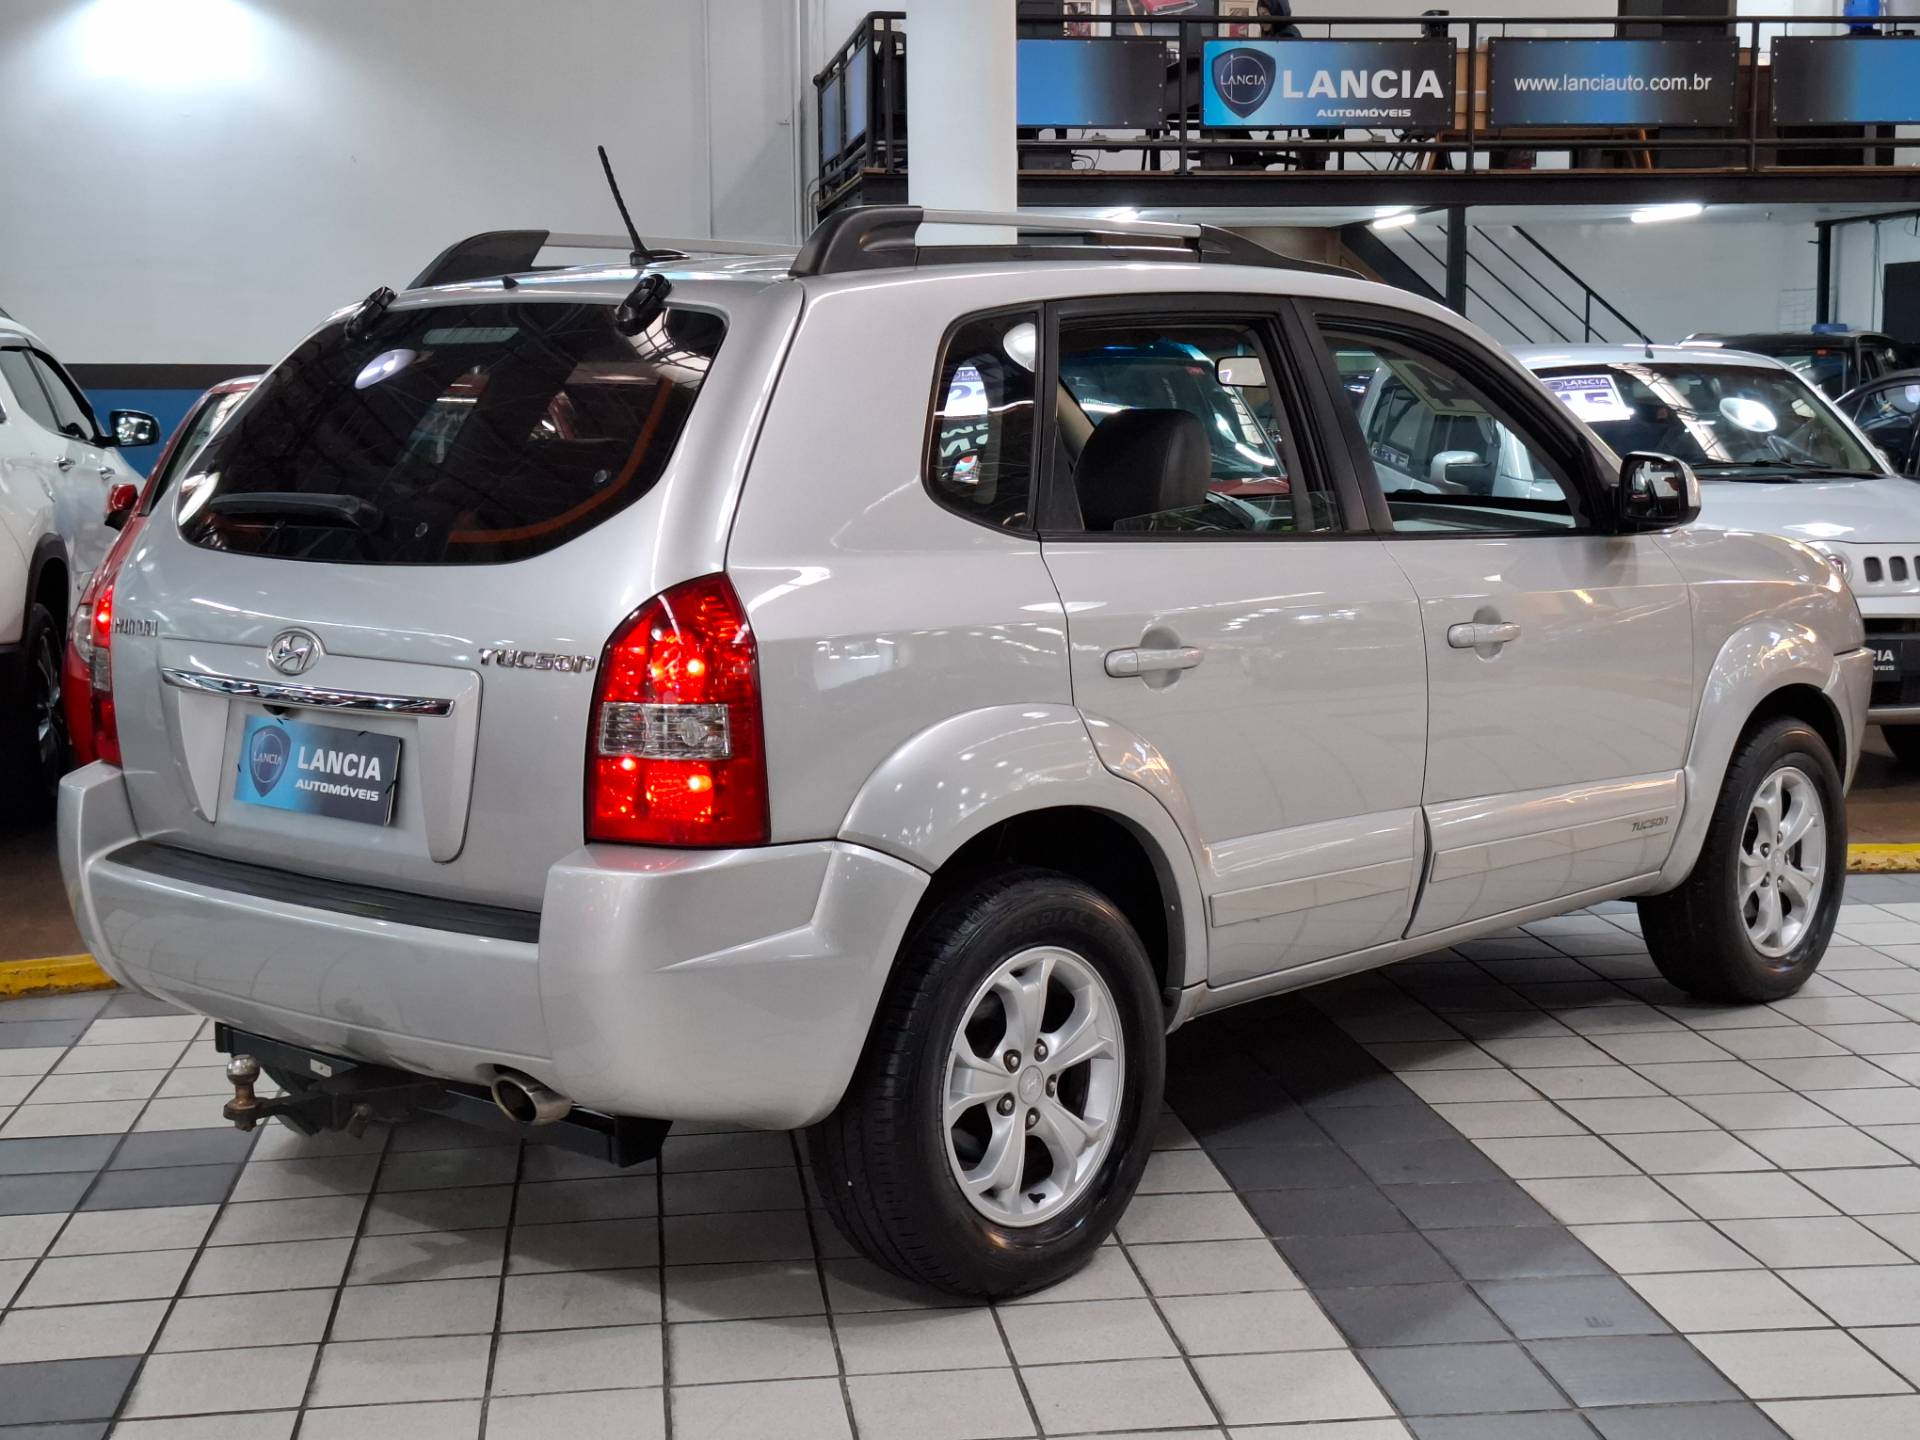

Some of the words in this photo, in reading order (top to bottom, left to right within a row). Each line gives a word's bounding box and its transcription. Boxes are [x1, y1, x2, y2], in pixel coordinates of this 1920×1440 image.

[1220, 74, 1265, 86] LANCIA
[1283, 70, 1444, 98] LANCIA
[1514, 73, 1712, 91] www.lanciauto.com.br
[1316, 107, 1412, 118] AUTOMÓVEIS
[1564, 378, 1608, 386] LANCIA
[478, 648, 596, 673] TUCSON
[253, 751, 283, 765] LANCIA
[298, 746, 381, 781] LANCIA
[295, 778, 379, 802] AUTOMÓVEIS
